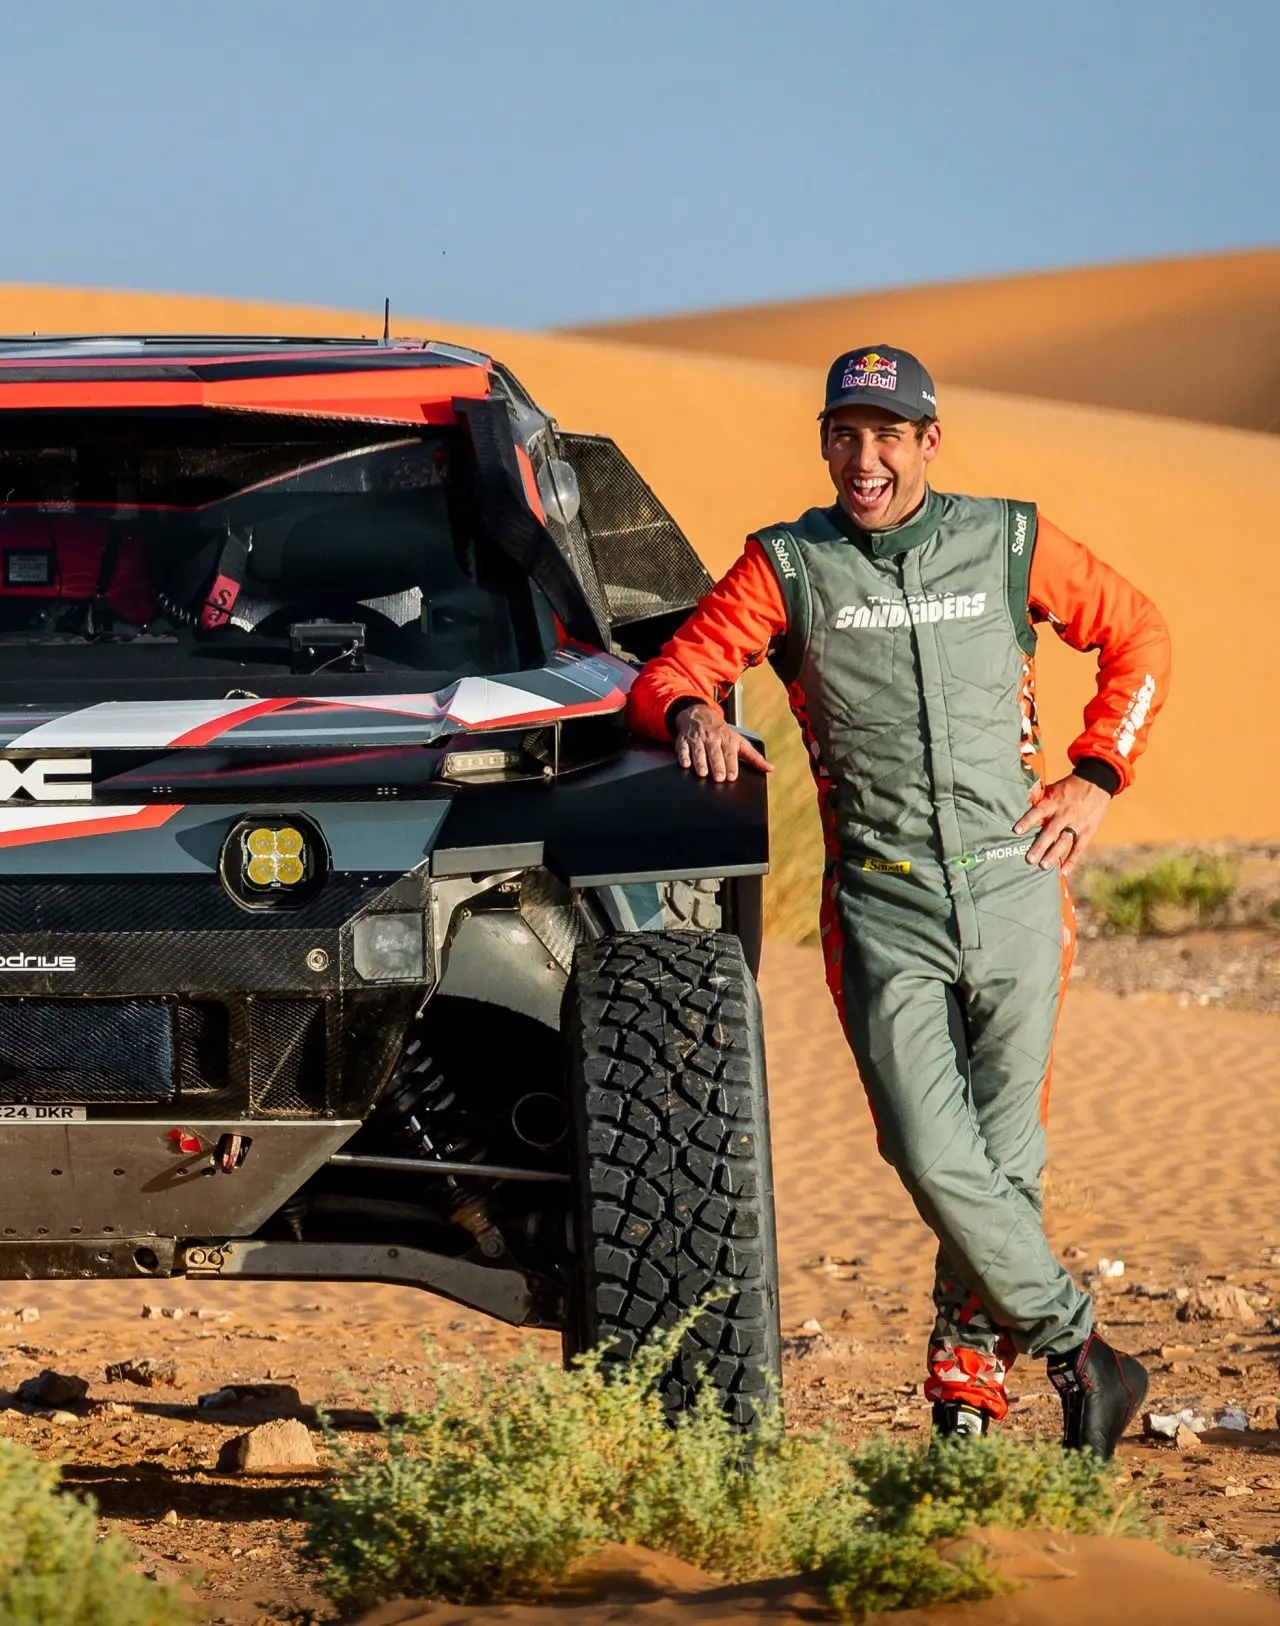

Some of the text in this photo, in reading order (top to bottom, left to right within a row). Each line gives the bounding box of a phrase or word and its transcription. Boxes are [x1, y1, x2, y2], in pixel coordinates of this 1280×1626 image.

[842, 372, 896, 391] Red Bull
[1011, 511, 1027, 556] Sabelt
[771, 538, 798, 580] Sabelt
[835, 592, 987, 629] SANDRIDERS
[35, 1107, 74, 1119] DKR
